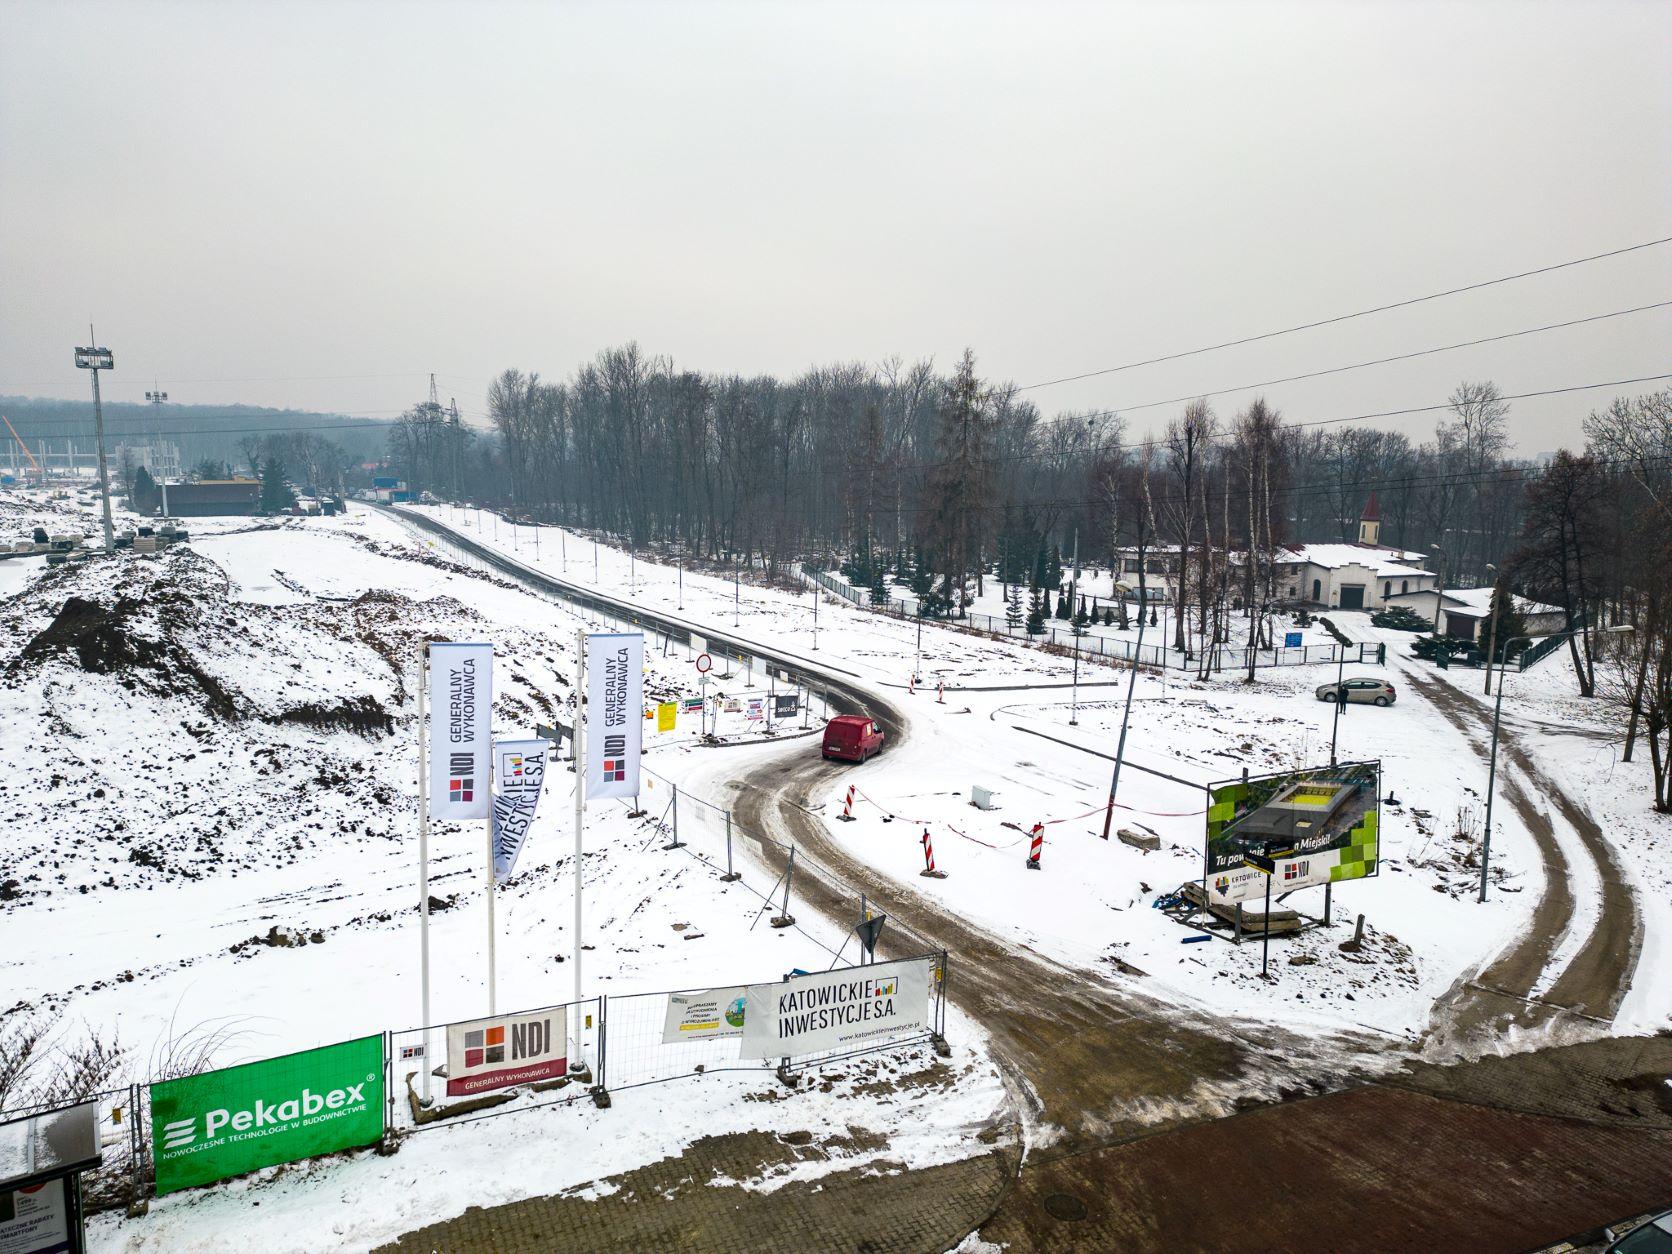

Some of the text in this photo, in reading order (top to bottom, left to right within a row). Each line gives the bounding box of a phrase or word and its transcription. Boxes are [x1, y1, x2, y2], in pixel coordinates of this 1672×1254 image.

[450, 669, 462, 743] GENERALNY
[463, 658, 475, 743] WYKONAWCA
[605, 657, 616, 727] GENERALNY
[616, 647, 628, 726] WYKONAWCA
[450, 752, 474, 776] NDI
[604, 734, 626, 758] NDI
[1216, 855, 1226, 866] Tu
[779, 980, 873, 1015] KATOWICKIE
[779, 998, 897, 1039] INWESTYCJE S.A.
[839, 1021, 921, 1042] www.katowickieinwestycje.pl
[512, 1019, 551, 1060] NDI
[465, 1067, 550, 1090] GENERALNY WYKONAWCA
[163, 1103, 367, 1160] NOWOCZESNE TECHNOLOGIE W BUDOWNICTWIE
